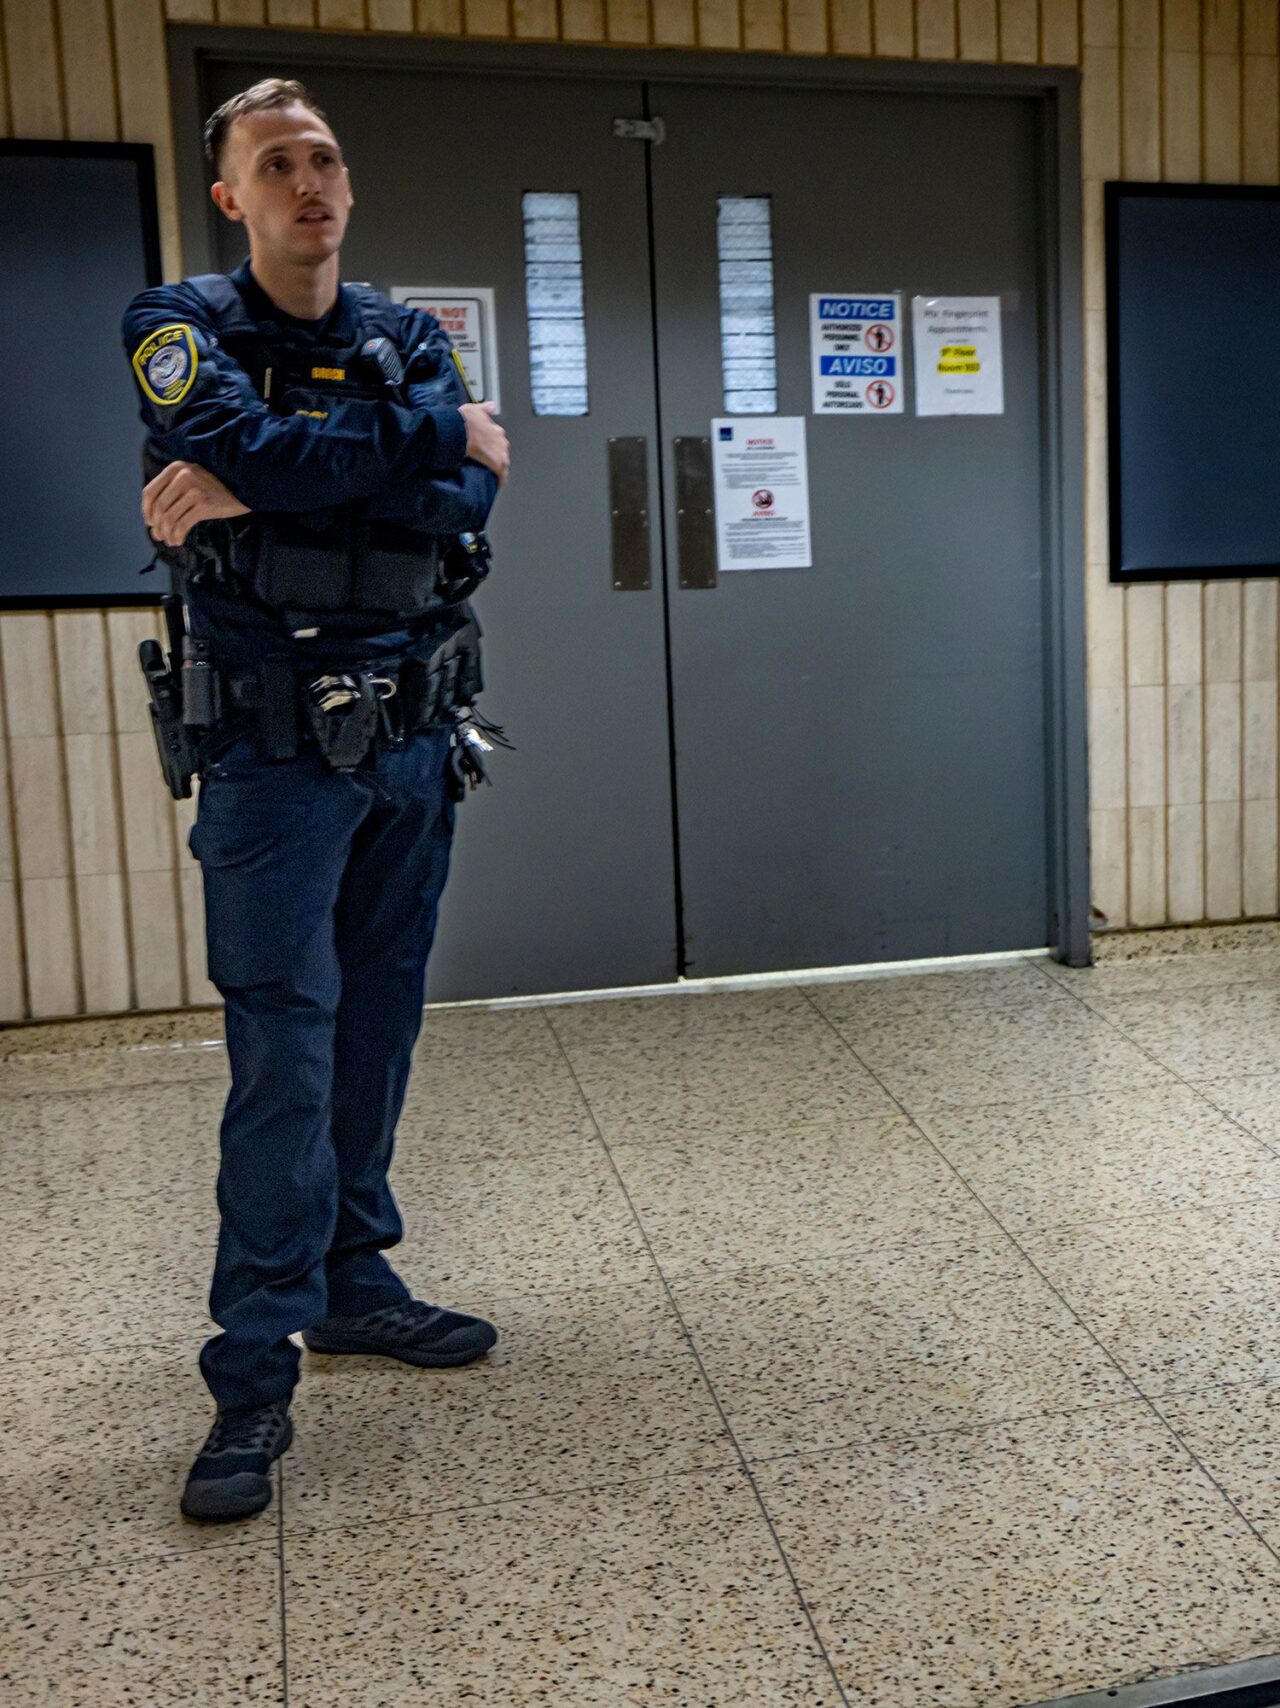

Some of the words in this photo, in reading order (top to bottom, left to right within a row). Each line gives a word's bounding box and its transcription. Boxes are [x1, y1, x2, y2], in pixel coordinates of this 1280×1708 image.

[441, 307, 467, 318] NOT
[822, 302, 891, 317] NOTICE
[440, 320, 466, 331] TER
[821, 323, 863, 332] AUTHORIZED
[823, 333, 860, 342] PERSONNEL
[139, 330, 184, 366] POLICE
[828, 358, 888, 374] AVISO
